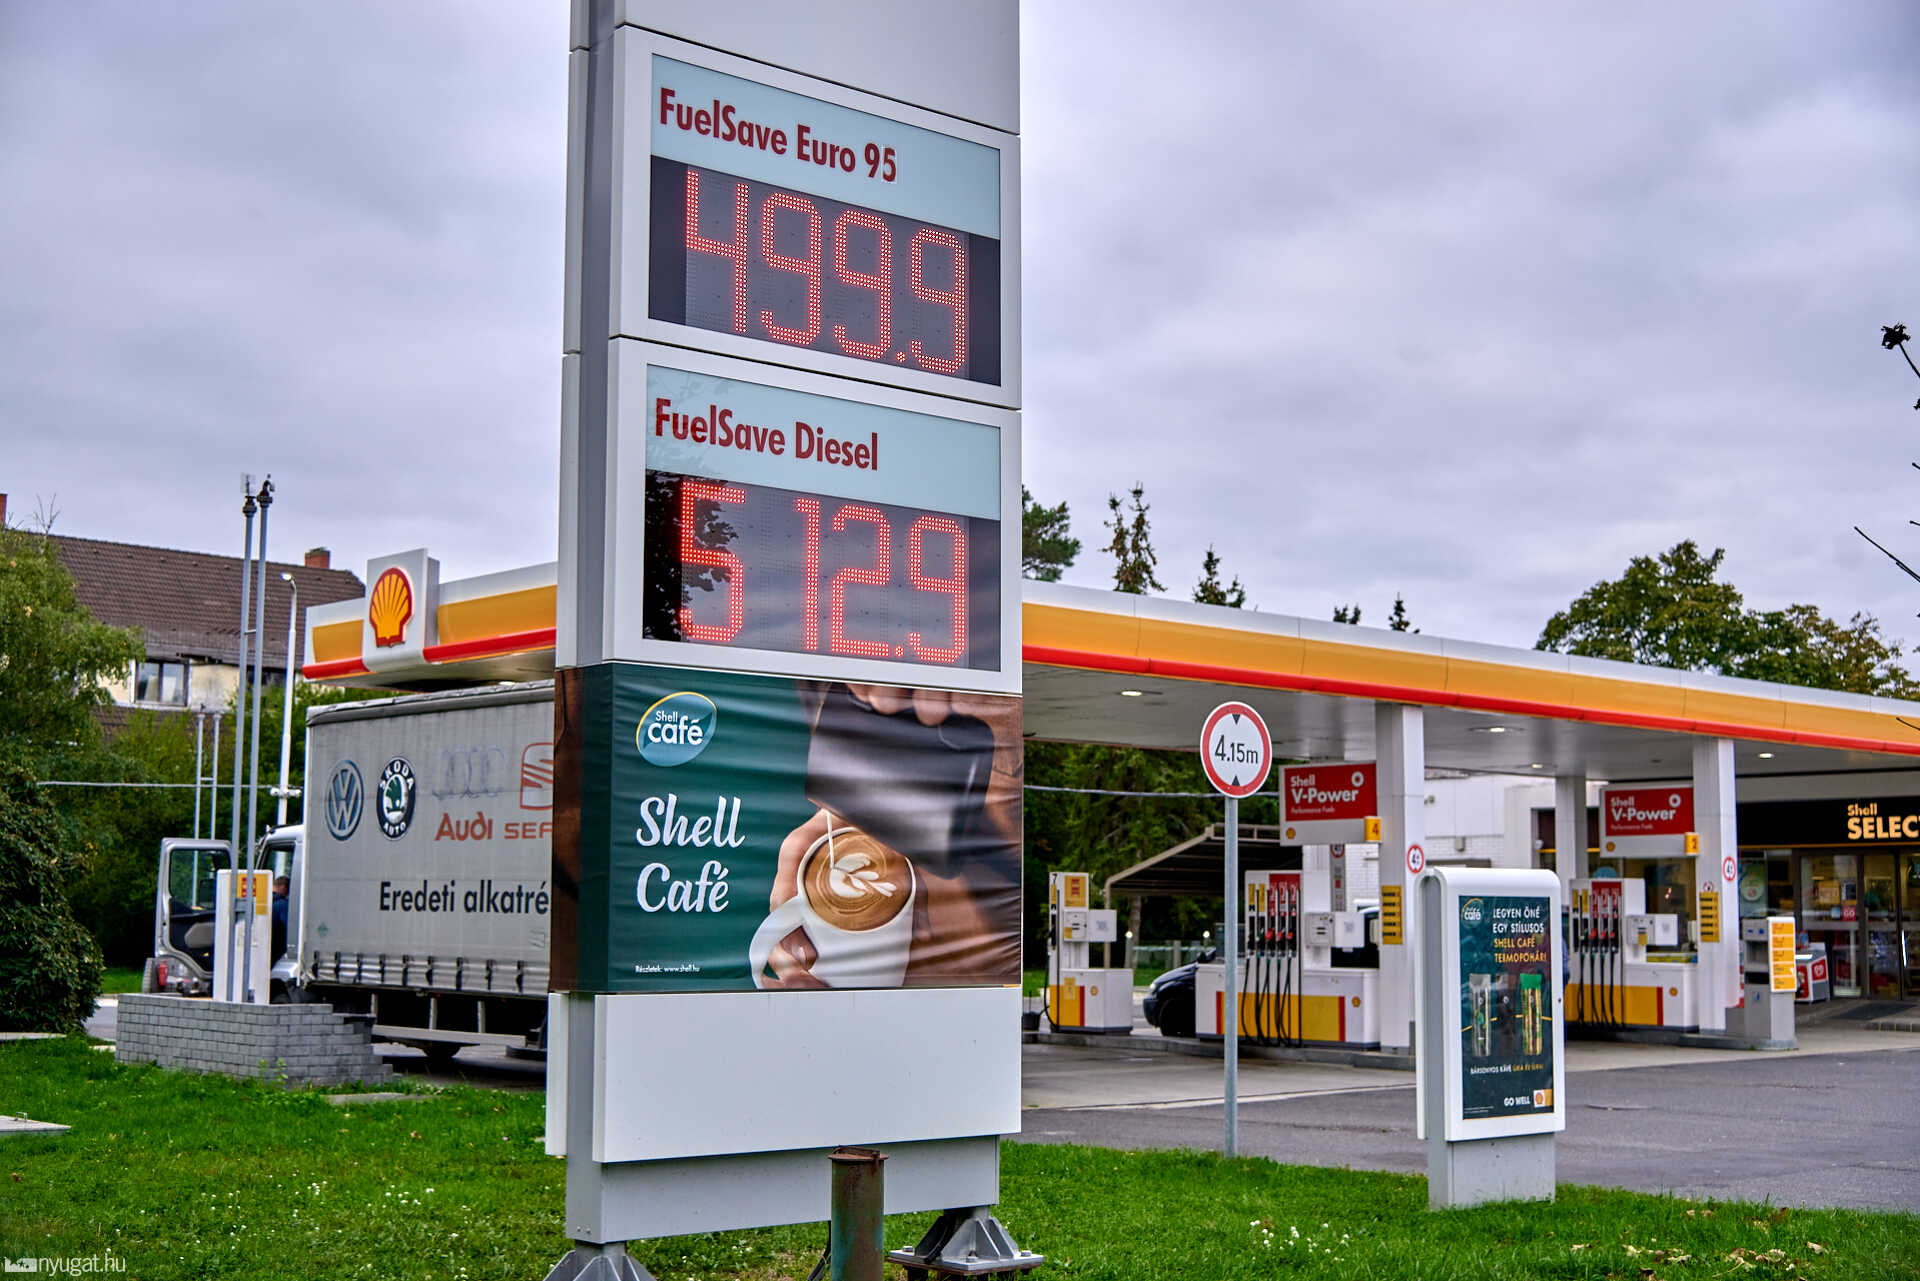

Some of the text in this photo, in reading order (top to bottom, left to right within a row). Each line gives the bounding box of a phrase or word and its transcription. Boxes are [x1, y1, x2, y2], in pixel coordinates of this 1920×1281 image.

[659, 87, 897, 182] FuelSave Euro 95
[685, 169, 967, 374] 499.9
[655, 397, 878, 470] FuelSave Diesel
[680, 481, 967, 664] 512.9
[656, 710, 678, 722] Shell
[648, 715, 703, 745] café
[1215, 734, 1258, 764] 4.15m
[1290, 774, 1316, 787] Shell
[1291, 787, 1359, 804] V-Power
[1611, 796, 1635, 808] Shell
[1611, 807, 1676, 821] V-Power
[1847, 803, 1878, 816] Shell
[636, 793, 746, 848] Shell
[1372, 823, 1379, 835] 4
[1847, 814, 1920, 840] SELEC
[637, 860, 729, 912] Café
[379, 879, 550, 915] Eredeti alkatré
[1492, 908, 1521, 918] LEGYEN
[1492, 920, 1545, 933] EGY STÍLUSOS
[1494, 935, 1536, 948] SHELL CAFÉ
[1503, 1096, 1531, 1107] GO WELL
